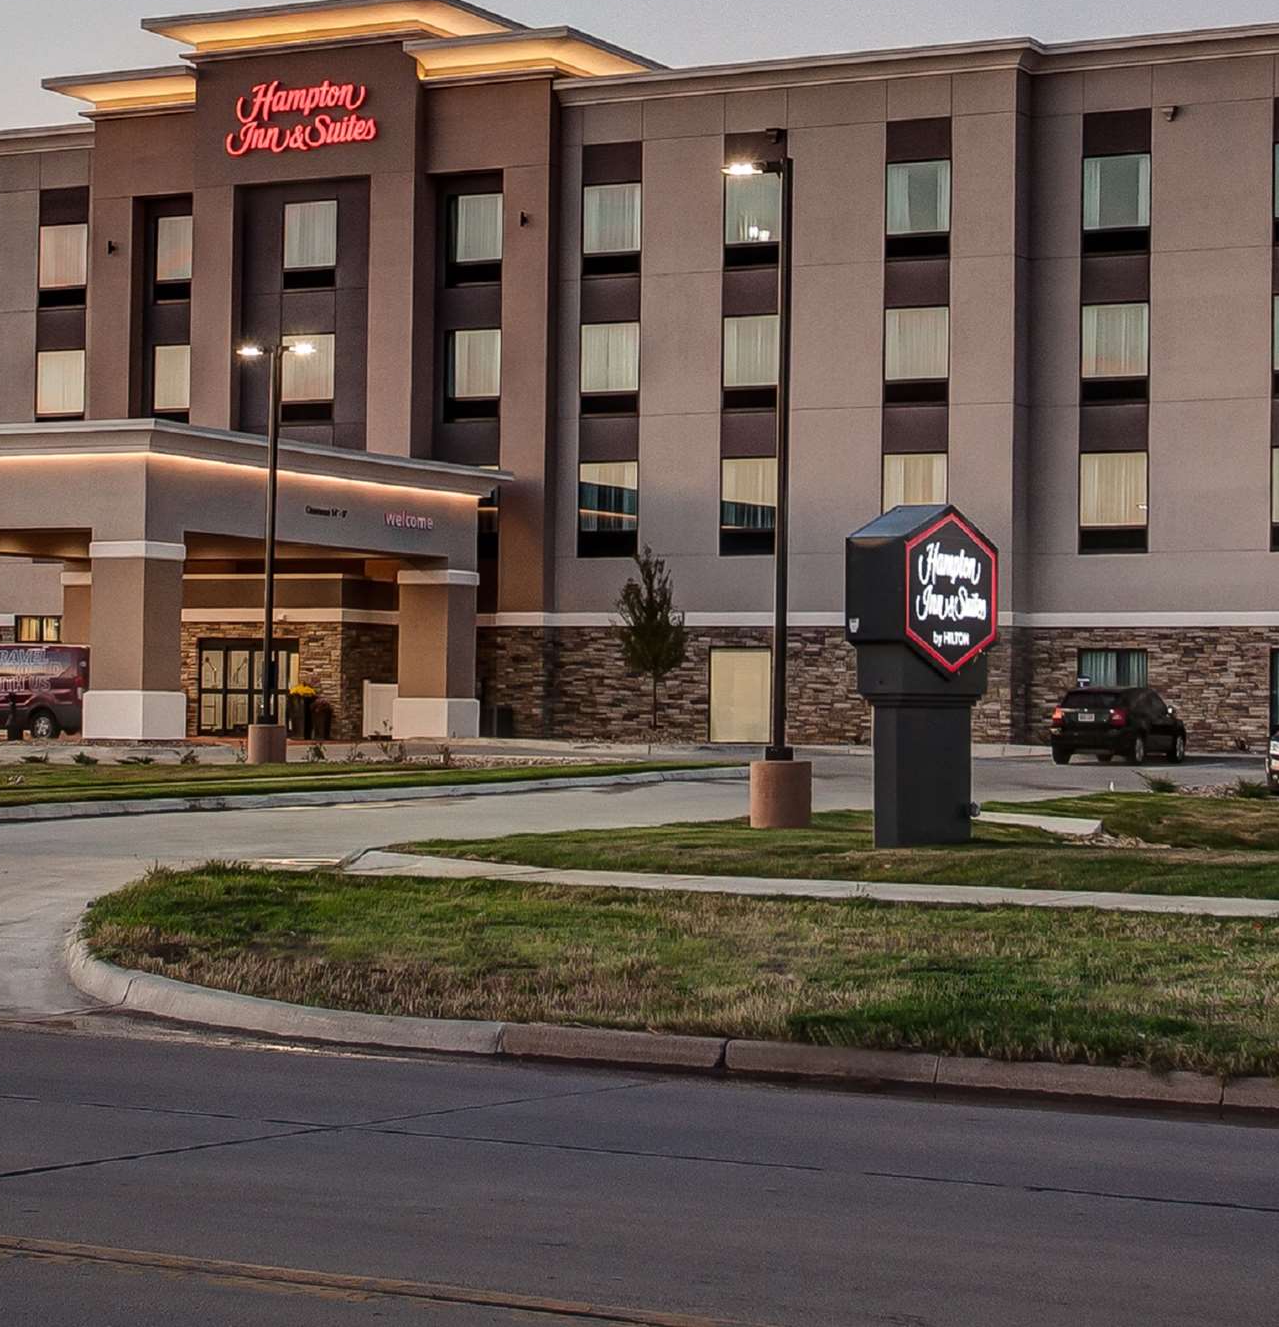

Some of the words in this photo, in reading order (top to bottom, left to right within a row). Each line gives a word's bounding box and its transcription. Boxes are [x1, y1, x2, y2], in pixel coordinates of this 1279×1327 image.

[236, 80, 366, 123] Hampton
[226, 121, 290, 156] Inn
[289, 125, 308, 150] &
[305, 114, 377, 147] Suites
[384, 510, 433, 530] welcome
[918, 542, 981, 585] Hampton
[933, 630, 942, 647] by
[29, 675, 52, 692] US
